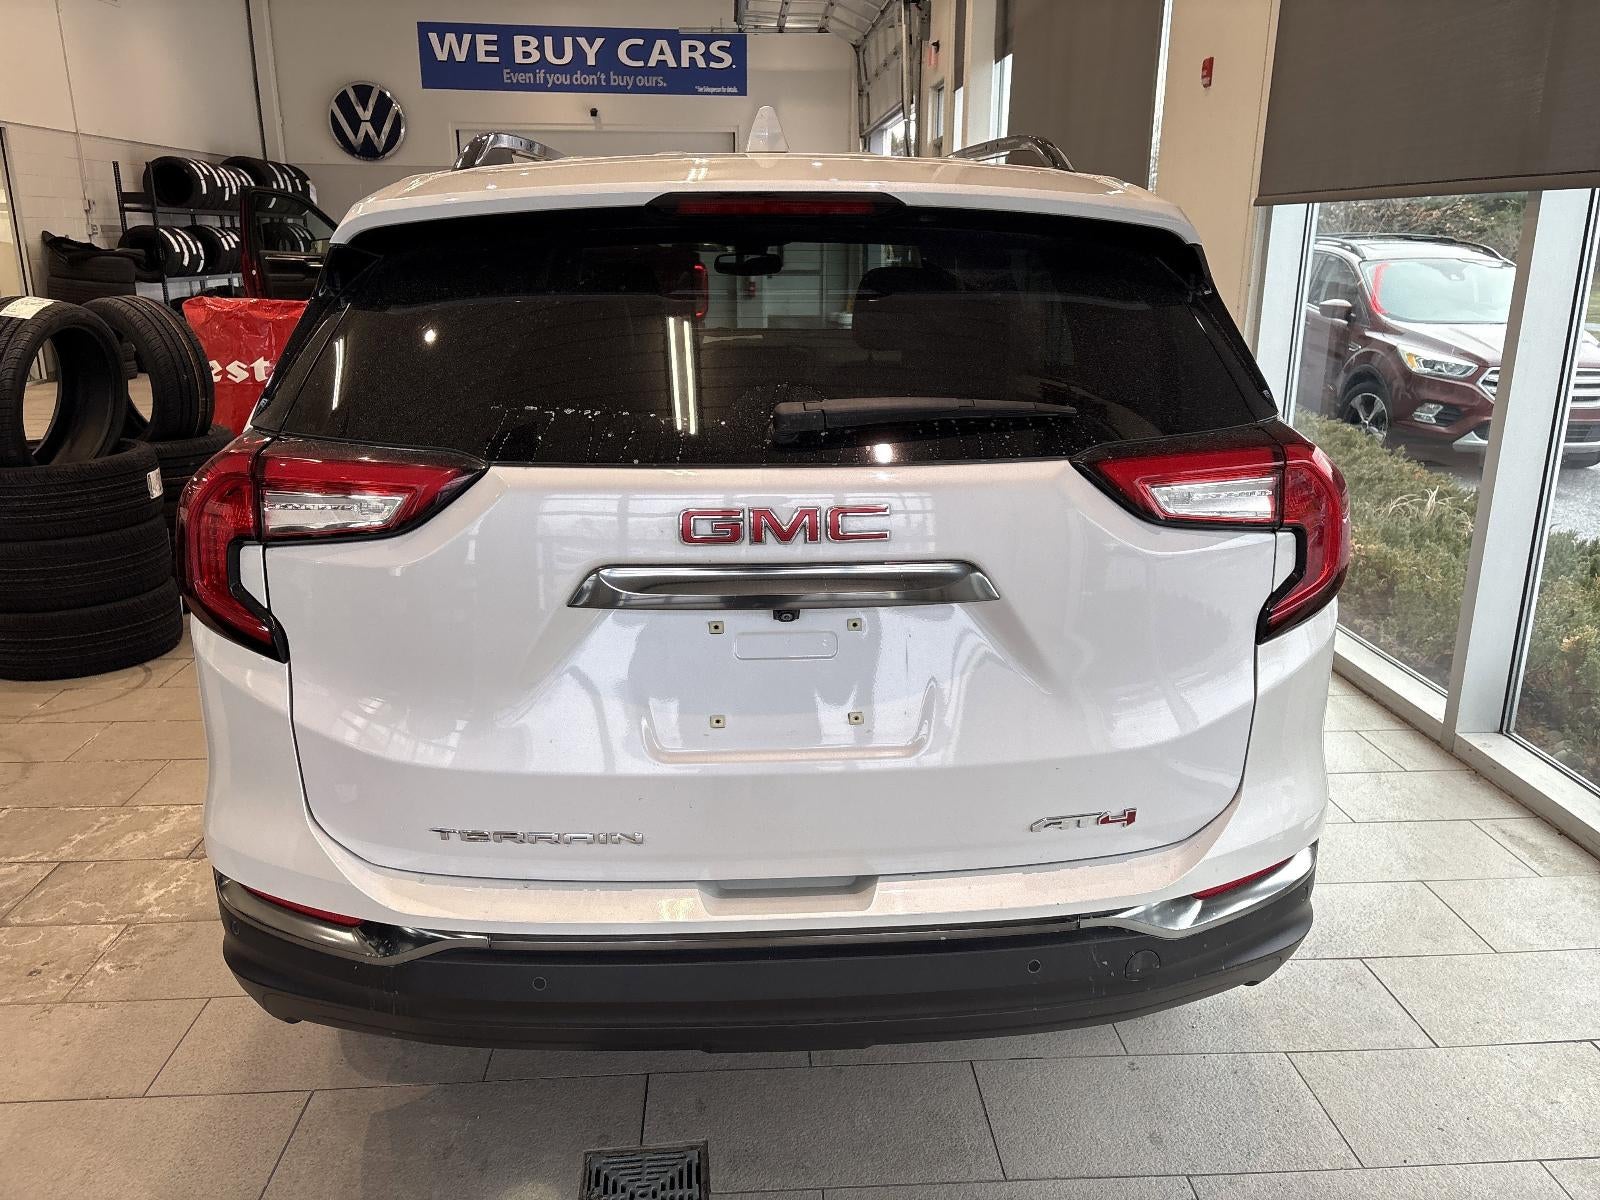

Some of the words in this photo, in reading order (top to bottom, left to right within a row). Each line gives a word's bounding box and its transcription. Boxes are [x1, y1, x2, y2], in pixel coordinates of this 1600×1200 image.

[428, 32, 500, 63] WE
[513, 35, 605, 67] BUY
[617, 38, 737, 69] CARS.
[503, 69, 533, 83] Even
[536, 69, 545, 84] if
[547, 74, 570, 87] you
[572, 70, 605, 86] don't
[610, 72, 635, 89] buy
[636, 75, 667, 87] ours.
[678, 504, 891, 546] GMC
[1030, 807, 1137, 833] AT4
[428, 826, 645, 846] TERRAIN
